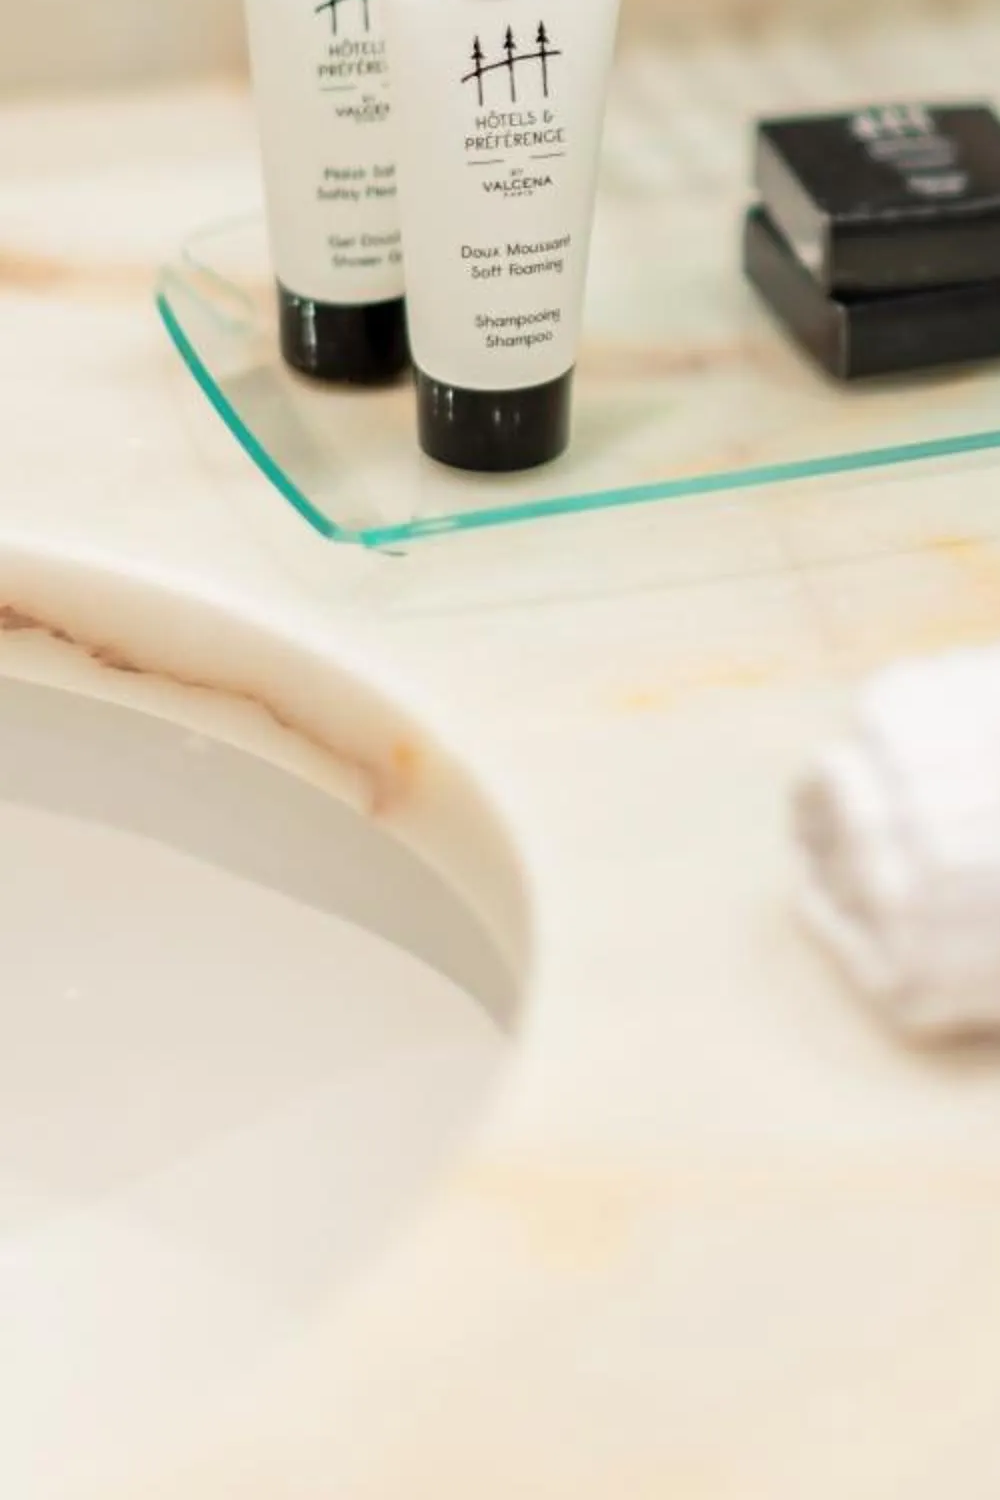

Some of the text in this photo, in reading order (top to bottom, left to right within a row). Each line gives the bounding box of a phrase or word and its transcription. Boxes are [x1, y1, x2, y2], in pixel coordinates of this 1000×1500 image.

[475, 110, 538, 130] HÔTELS
[464, 127, 566, 152] PRÉFÉRENCE
[482, 176, 553, 192] VALCENA
[461, 233, 571, 259] Doux Moussant
[471, 259, 564, 279] Soft Foaming
[475, 308, 561, 329] Shampooing
[485, 331, 553, 349] Shampoo
